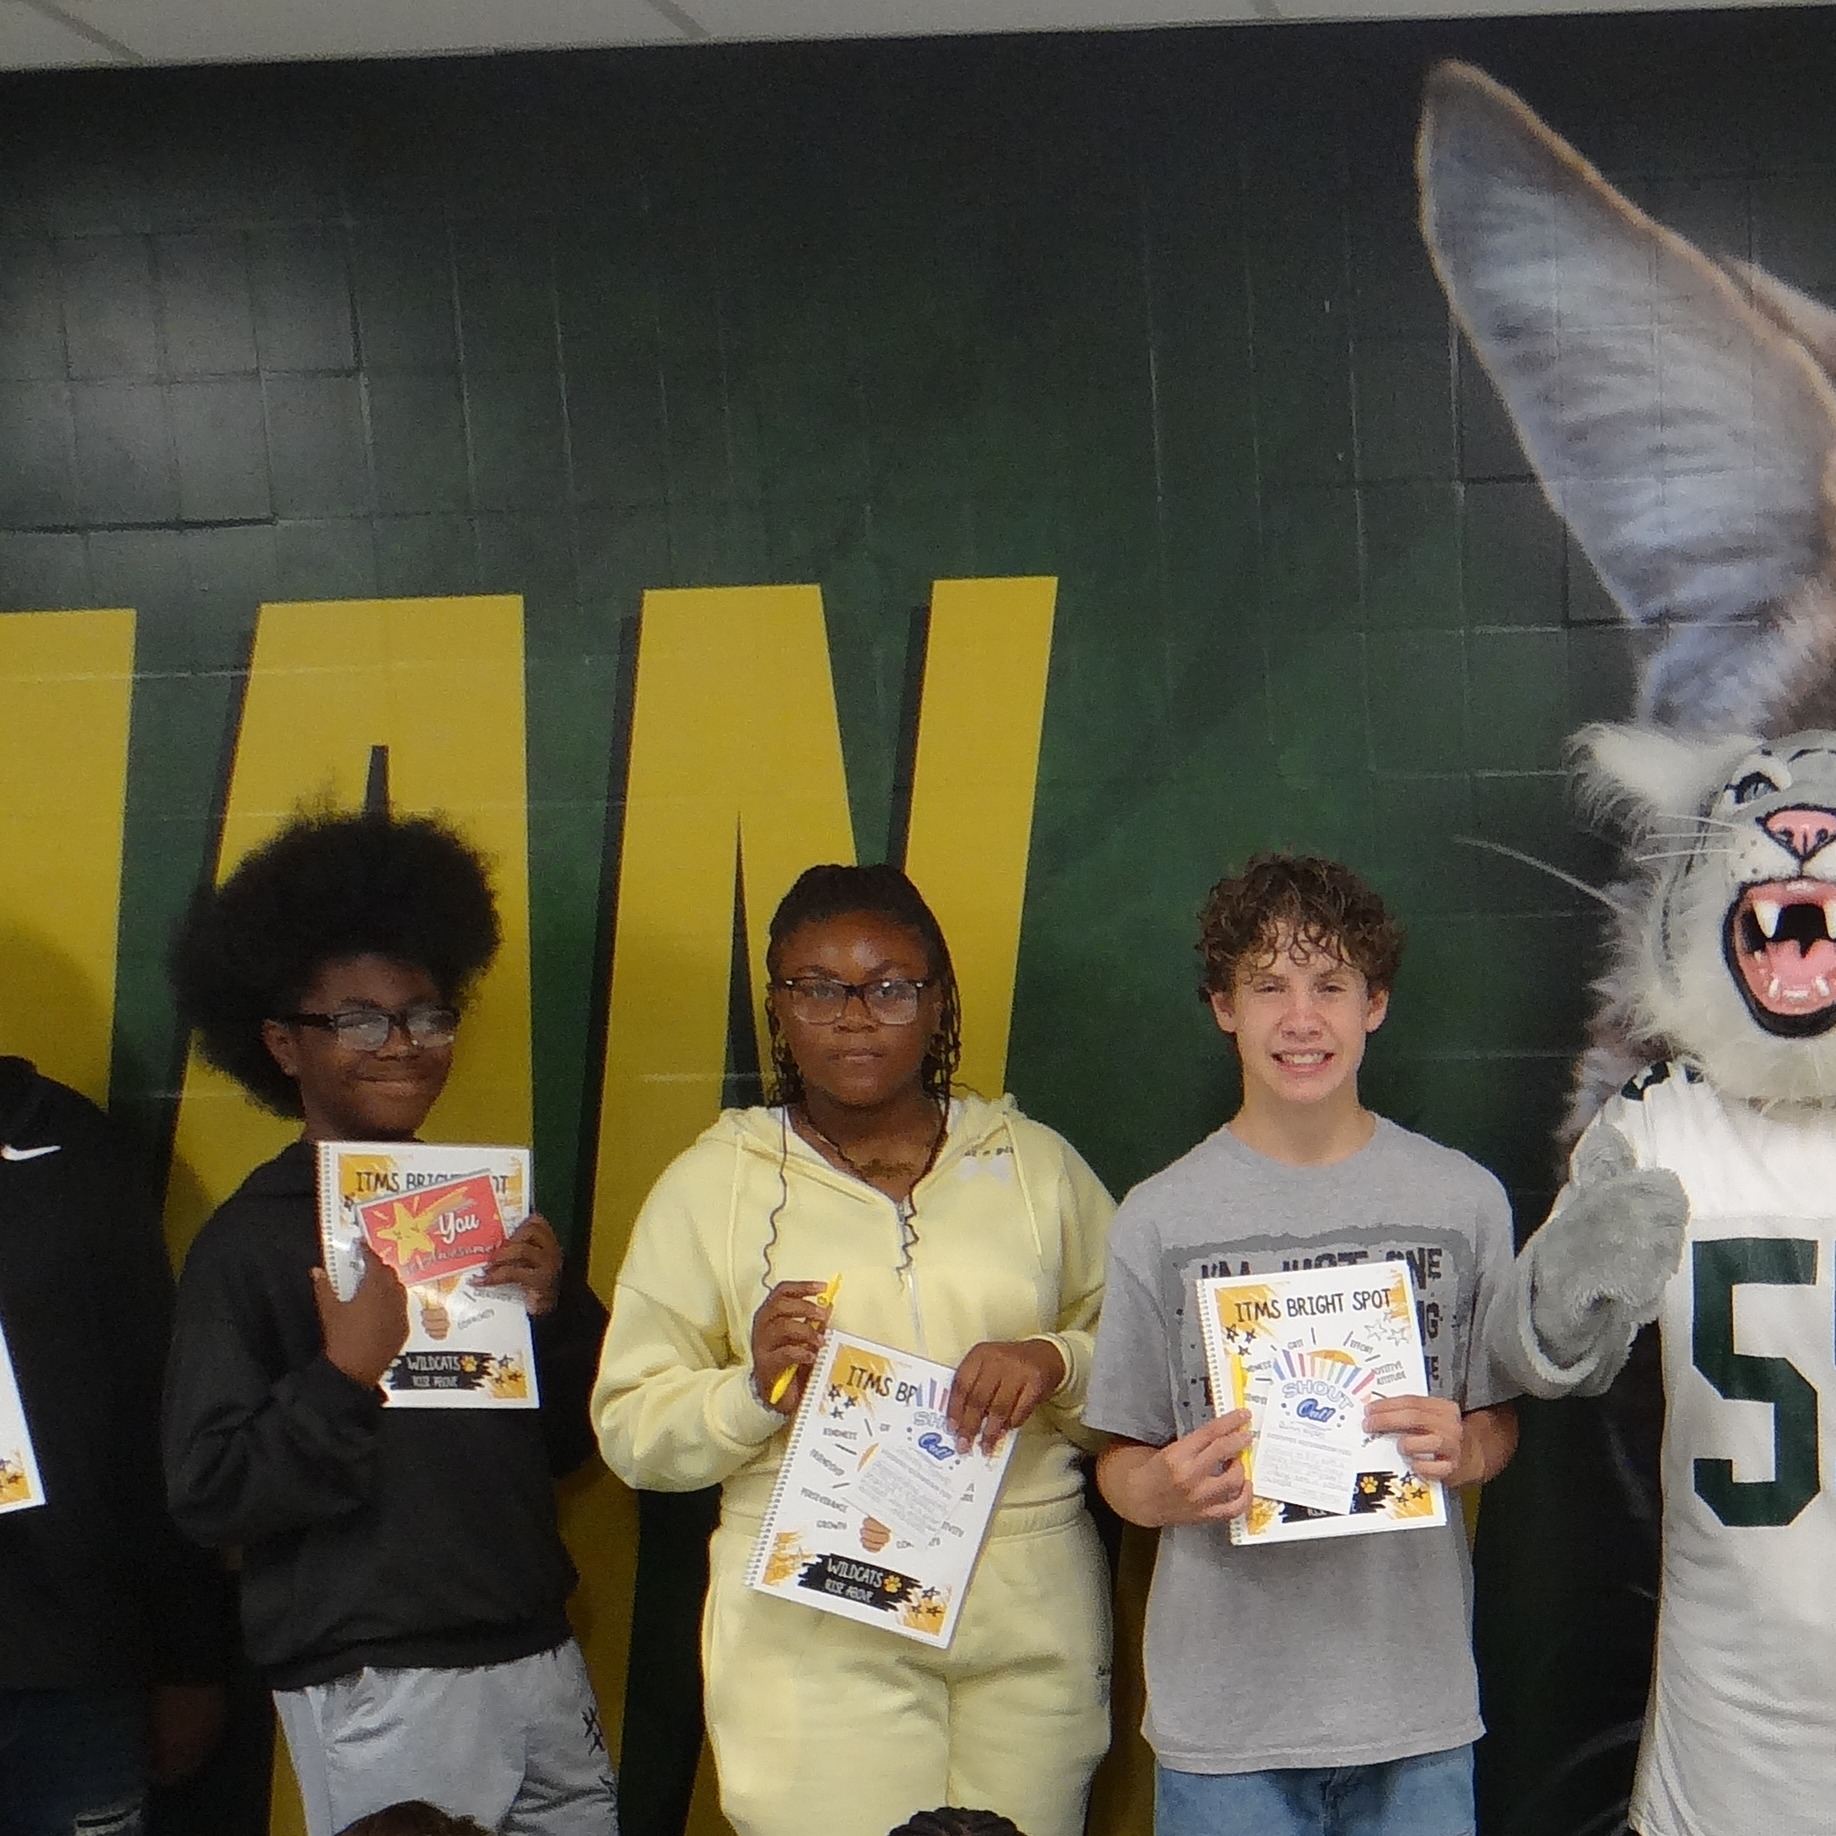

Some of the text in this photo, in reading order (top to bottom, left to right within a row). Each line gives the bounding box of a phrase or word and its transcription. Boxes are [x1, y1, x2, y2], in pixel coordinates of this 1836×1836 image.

[356, 1172, 399, 1193] ITMS
[438, 1211, 480, 1245] You
[1235, 1288, 1391, 1322] ITMS BRIGHT SPOT
[846, 1365, 893, 1397] ITMS
[1282, 1379, 1354, 1411] SHOUT
[827, 1558, 884, 1588] WILDCATS
